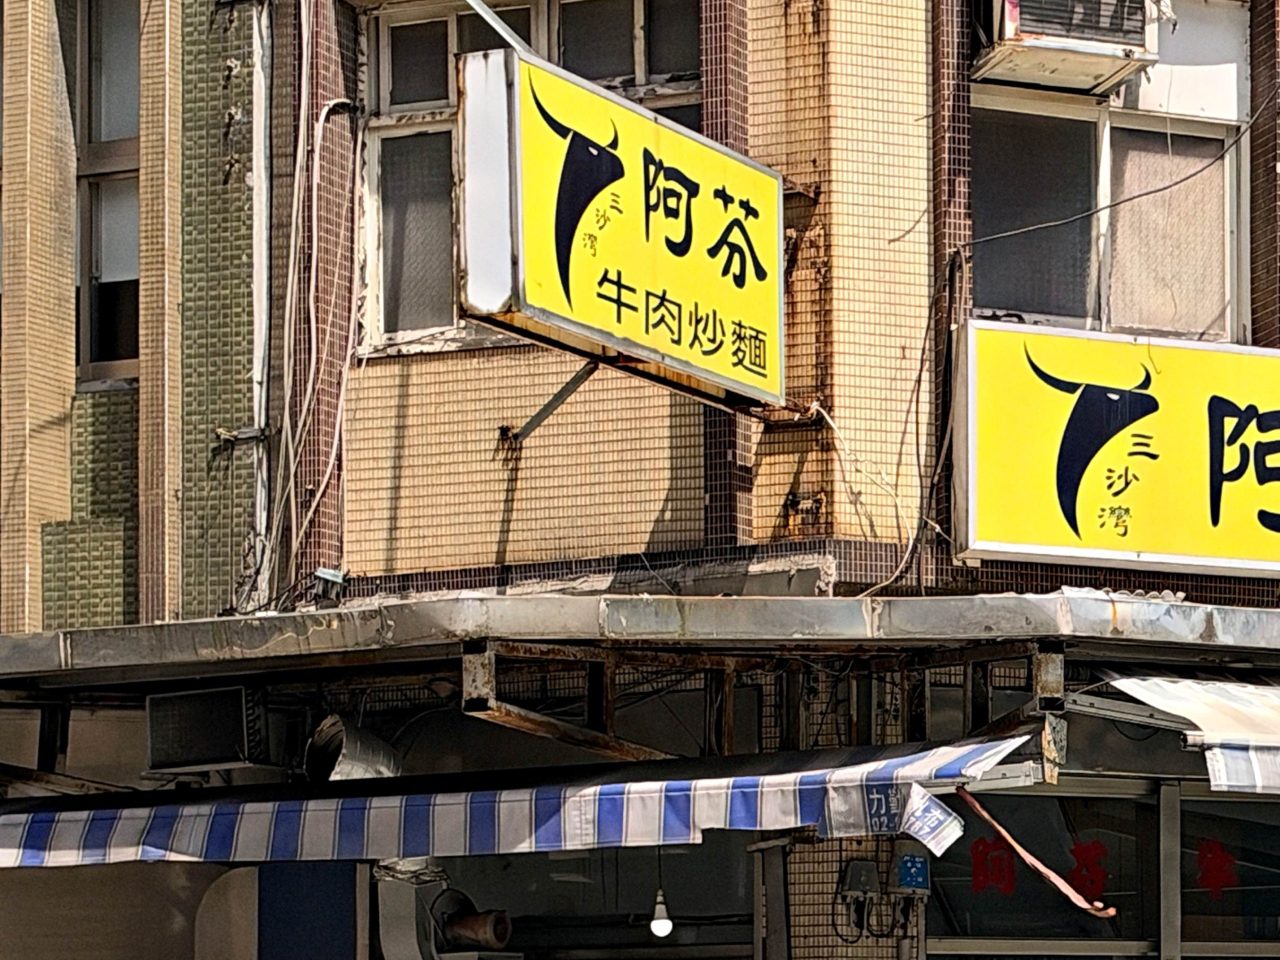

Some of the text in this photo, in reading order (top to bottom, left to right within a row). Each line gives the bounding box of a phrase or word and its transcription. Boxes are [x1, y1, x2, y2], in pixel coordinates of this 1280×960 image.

[582, 192, 623, 259] 三沙灣
[643, 147, 768, 290] 阿芬
[596, 268, 768, 379] 牛肉炒麵
[1097, 432, 1159, 539] 三沙灣
